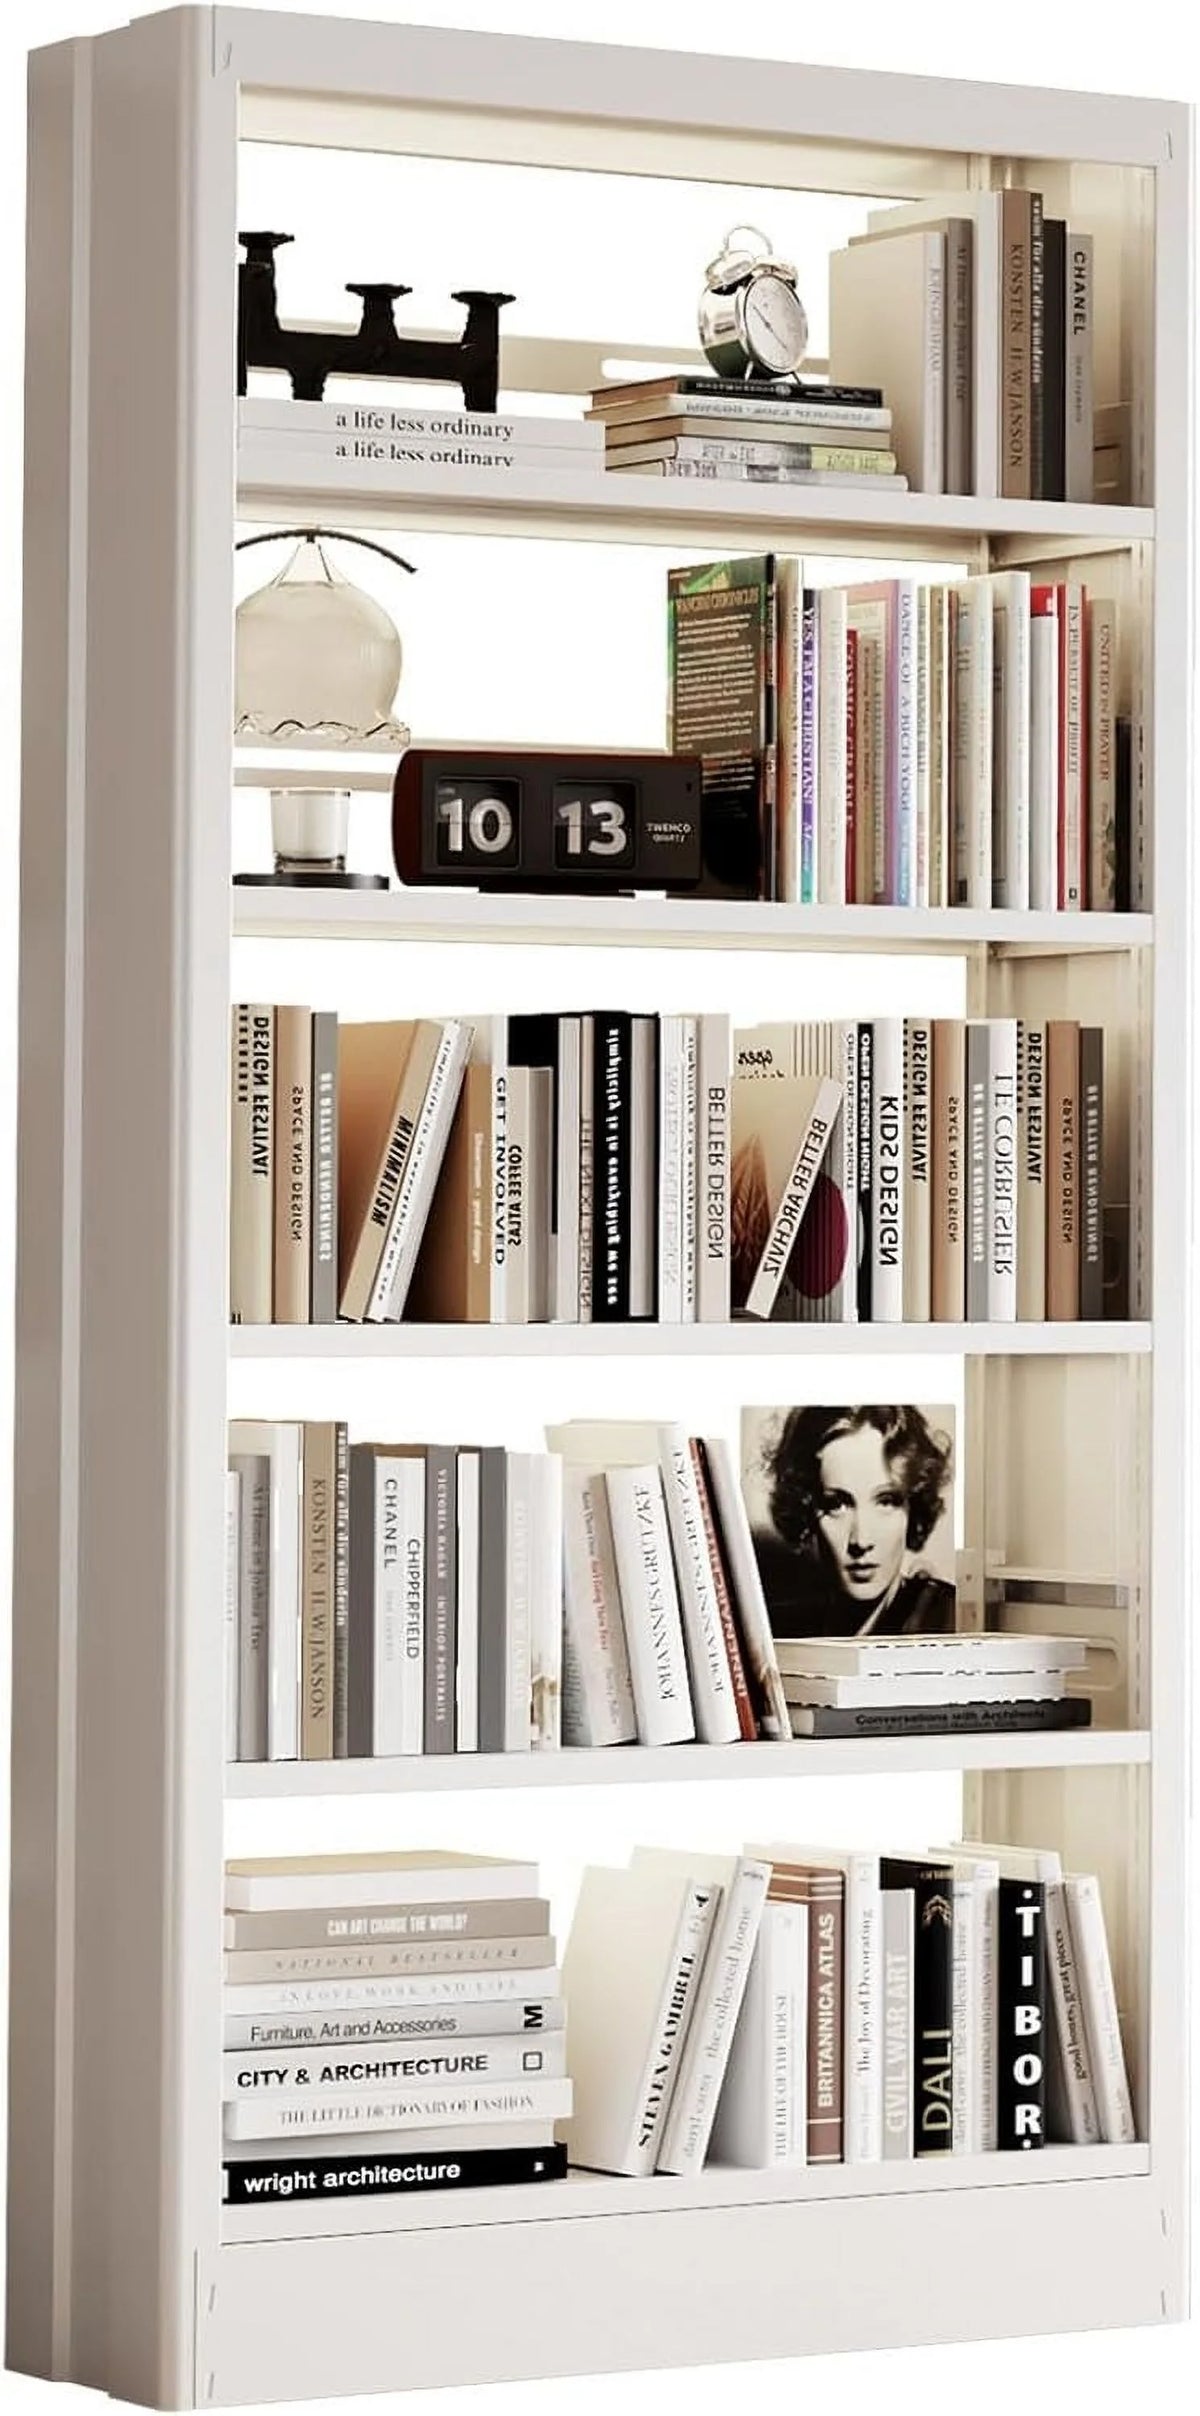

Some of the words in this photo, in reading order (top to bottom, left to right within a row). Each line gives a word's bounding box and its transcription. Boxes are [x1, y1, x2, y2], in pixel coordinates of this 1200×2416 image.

[1010, 243, 1024, 333] KONSTEN
[1073, 251, 1086, 336] CHANEL
[335, 413, 347, 427] a
[353, 410, 385, 430] life
[390, 413, 425, 433] less
[429, 418, 514, 443] ordinary
[335, 444, 347, 458] a
[353, 441, 385, 460] life
[389, 444, 425, 463] less
[429, 449, 514, 467] ordinary
[1007, 393, 1023, 468] JANSON
[900, 593, 911, 657] DANCE
[1099, 624, 1111, 695] UNITED
[1099, 718, 1111, 781] PRAYER
[439, 798, 513, 853] 10
[558, 799, 628, 856] 13
[496, 1077, 506, 1126] GET
[372, 1115, 414, 1228] MINIMALISM
[495, 1133, 506, 1265] INVOLVED
[311, 1479, 327, 1575] KONSTEN
[383, 1478, 398, 1570] CHANEL
[436, 1468, 448, 1531] VICTORIA
[406, 1538, 421, 1660] CHIPPERFIELD
[436, 1594, 447, 1651] INTERIOR
[308, 1639, 326, 1720] JANSON
[275, 1955, 375, 1970] NATIONAL
[389, 1948, 519, 1965] BESTSELLER
[818, 1912, 836, 1979] ATLAS
[856, 1907, 873, 1996] Decorating
[886, 1950, 908, 1999] ART
[713, 1956, 740, 2028] collected
[1012, 1905, 1043, 2136] TIBOR
[320, 2022, 340, 2038] Art
[343, 2020, 370, 2037] and
[373, 2016, 457, 2034] Accessories
[638, 2063, 669, 2147] STEVEN
[659, 1953, 696, 2057] GAMBREL
[817, 1983, 836, 2109] BRITANNICA
[856, 2019, 873, 2043] Joy
[856, 2046, 871, 2071] The
[886, 2006, 908, 2064] WAR
[237, 2069, 289, 2088] CITY
[295, 2068, 310, 2085] &
[320, 2054, 489, 2083] ARCHITECTURE
[885, 2062, 908, 2134] CIVIL
[922, 2028, 954, 2132] DALI
[281, 2109, 305, 2125] THE
[312, 2105, 361, 2123] LITTLE
[367, 2101, 447, 2119] DICTIONARY
[450, 2099, 471, 2113] OF
[474, 2094, 534, 2111] FASHION
[244, 2169, 317, 2195] wright
[322, 2161, 461, 2188] architecture
